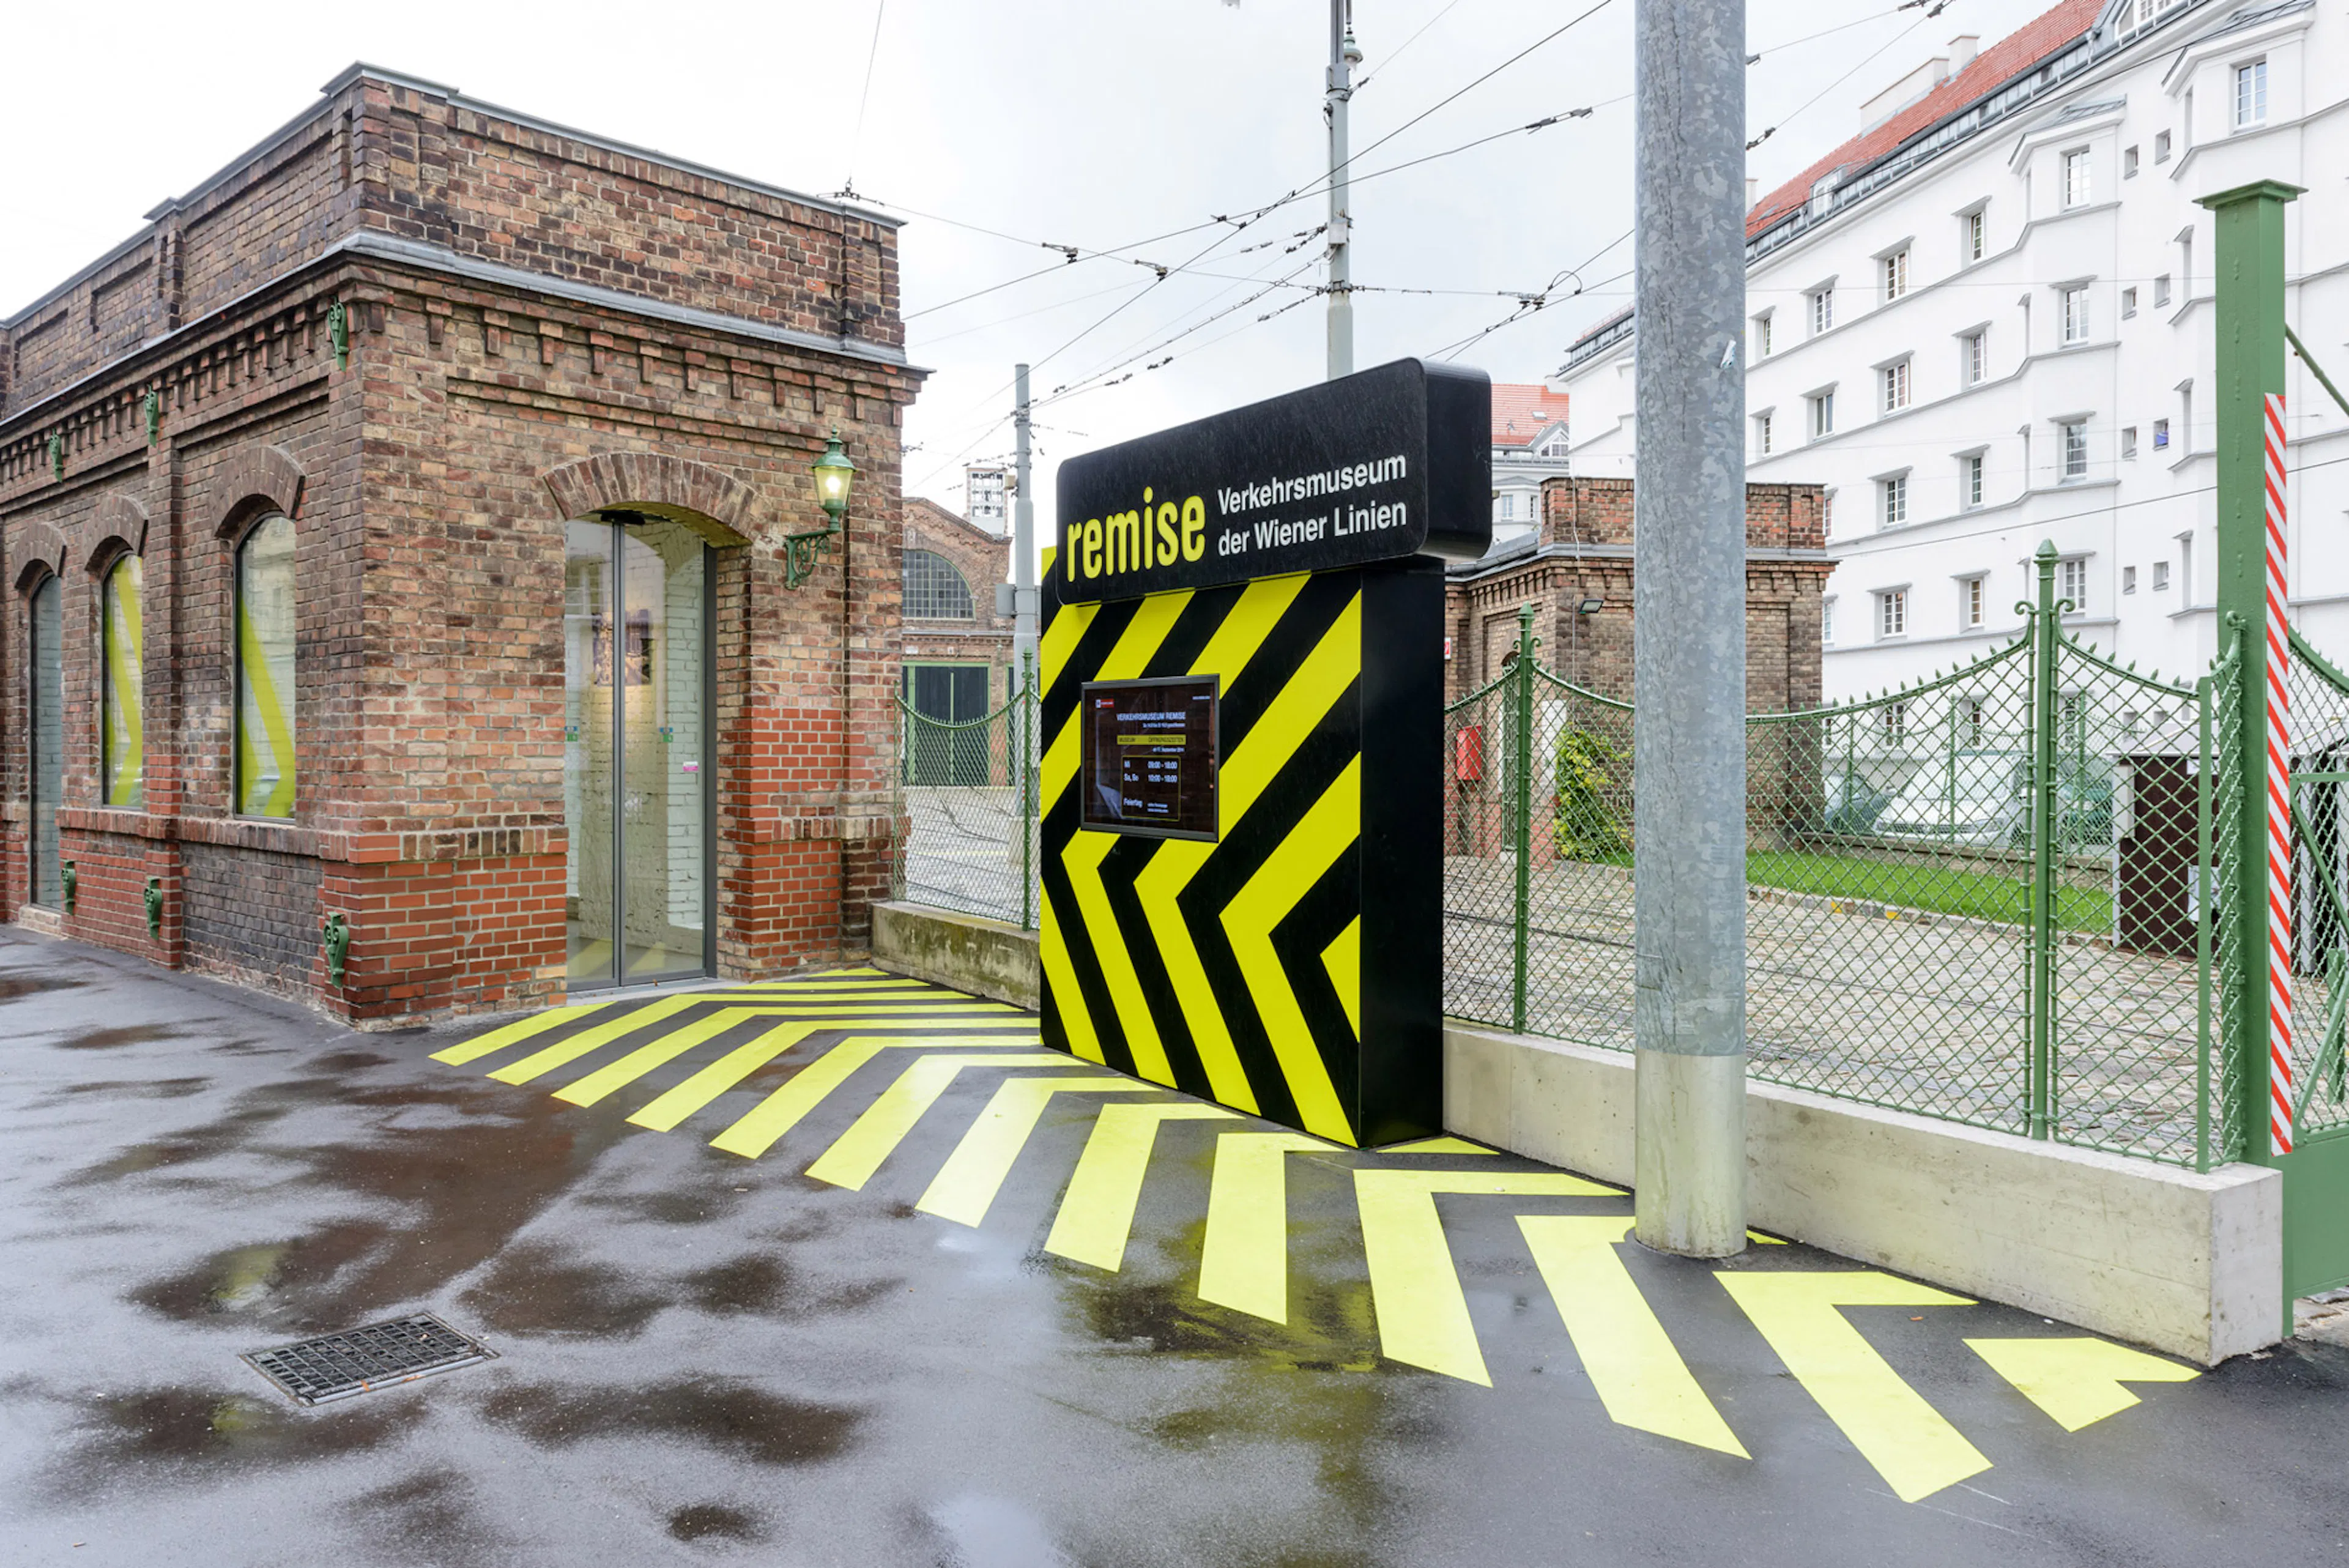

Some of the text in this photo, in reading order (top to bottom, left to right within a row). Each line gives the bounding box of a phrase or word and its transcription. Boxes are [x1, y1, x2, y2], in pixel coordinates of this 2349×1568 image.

[1217, 455, 1406, 515] Verkehrsmuseum
[1067, 486, 1206, 582] remise
[1218, 500, 1407, 556] der Wiener Linien
